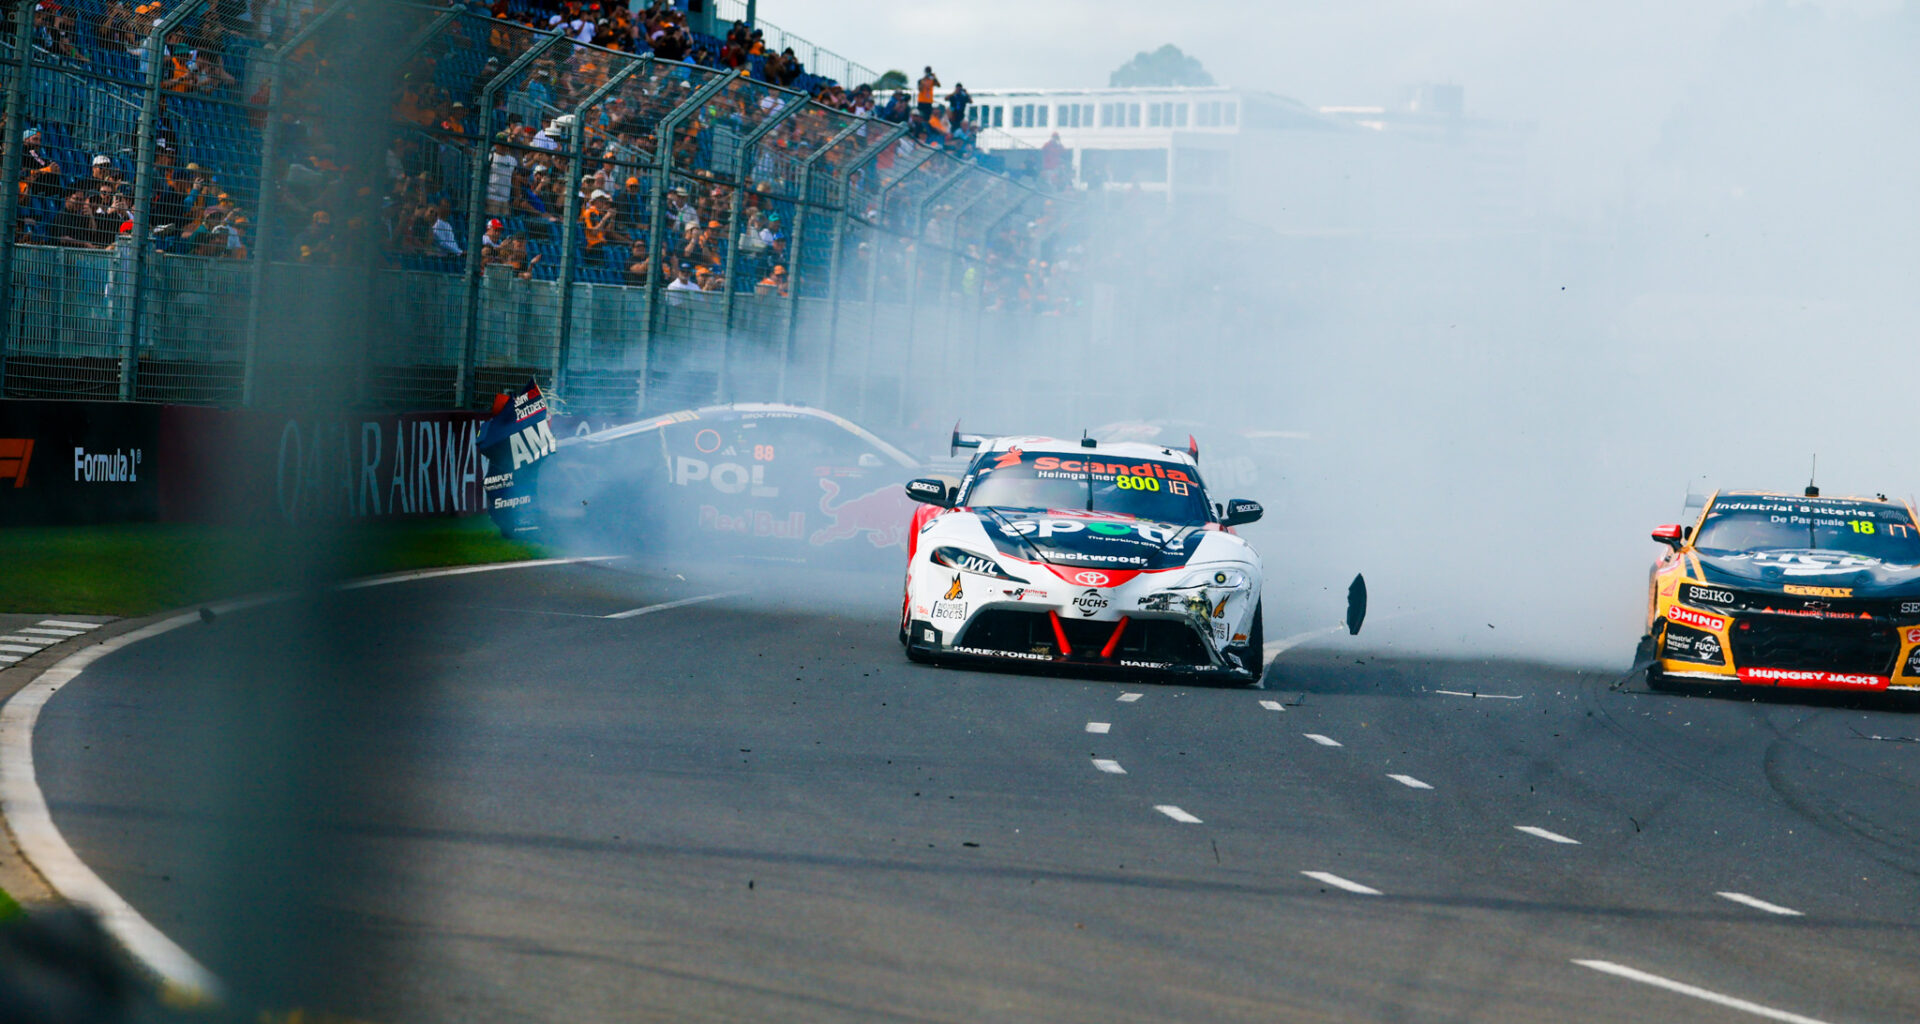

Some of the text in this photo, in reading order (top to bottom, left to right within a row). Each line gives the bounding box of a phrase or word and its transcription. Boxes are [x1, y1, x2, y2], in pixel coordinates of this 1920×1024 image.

[514, 398, 546, 421] Partners
[509, 419, 556, 470] AM
[754, 444, 775, 462] 88
[74, 446, 128, 482] Formula
[1033, 456, 1190, 482] Scandia
[676, 455, 780, 497] POL
[1116, 476, 1160, 491] 800
[1715, 502, 1876, 518] Industrial Batteries
[1771, 515, 1787, 523] De
[1847, 520, 1875, 535] 18
[960, 556, 998, 575] JWL
[1035, 550, 1148, 567] Blackwoods
[1072, 597, 1109, 608] FUCHS
[1689, 586, 1735, 604] SEIKO
[1825, 611, 1856, 619] TRUST
[1900, 602, 1920, 613] SE
[1680, 610, 1723, 630] HINO
[1694, 641, 1720, 653] FUCHS
[1749, 668, 1825, 680] HUNGRY
